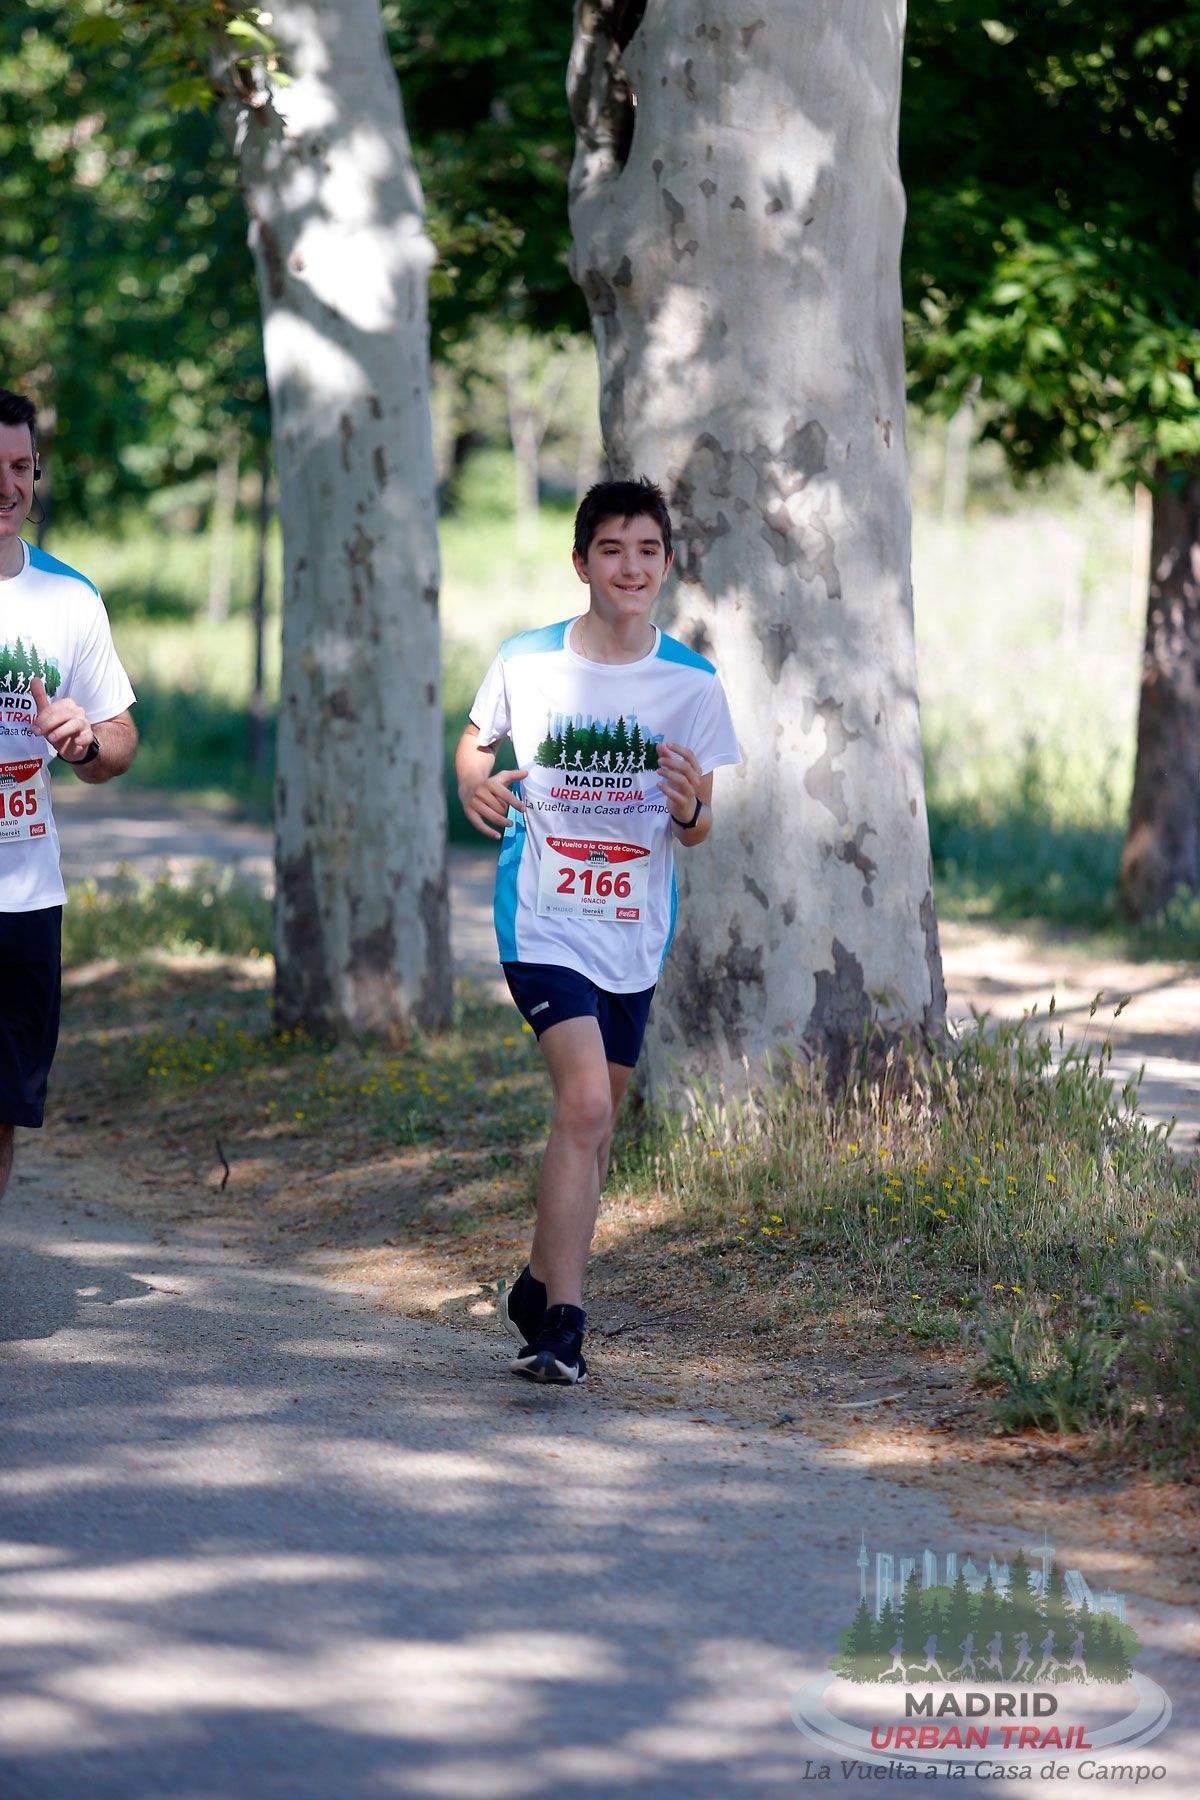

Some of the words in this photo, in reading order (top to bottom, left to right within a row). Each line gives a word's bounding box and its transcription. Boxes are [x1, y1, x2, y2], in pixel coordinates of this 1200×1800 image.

[0, 697, 32, 710] RID
[6, 711, 38, 724] TRAI
[21, 727, 32, 737] de
[565, 774, 633, 789] MADRID
[550, 787, 603, 801] URBAN
[606, 790, 645, 802] TRAIL
[525, 799, 534, 810] La
[537, 801, 570, 812] Vuelta
[572, 806, 579, 814] a
[582, 804, 591, 814] la
[594, 805, 621, 815] Casa
[623, 805, 635, 814] de
[1, 819, 19, 827] DAVID
[561, 841, 582, 849] Vuelta
[597, 843, 613, 851] Casa
[613, 844, 622, 852] de
[622, 845, 645, 855] Campo
[556, 867, 631, 898] 2166
